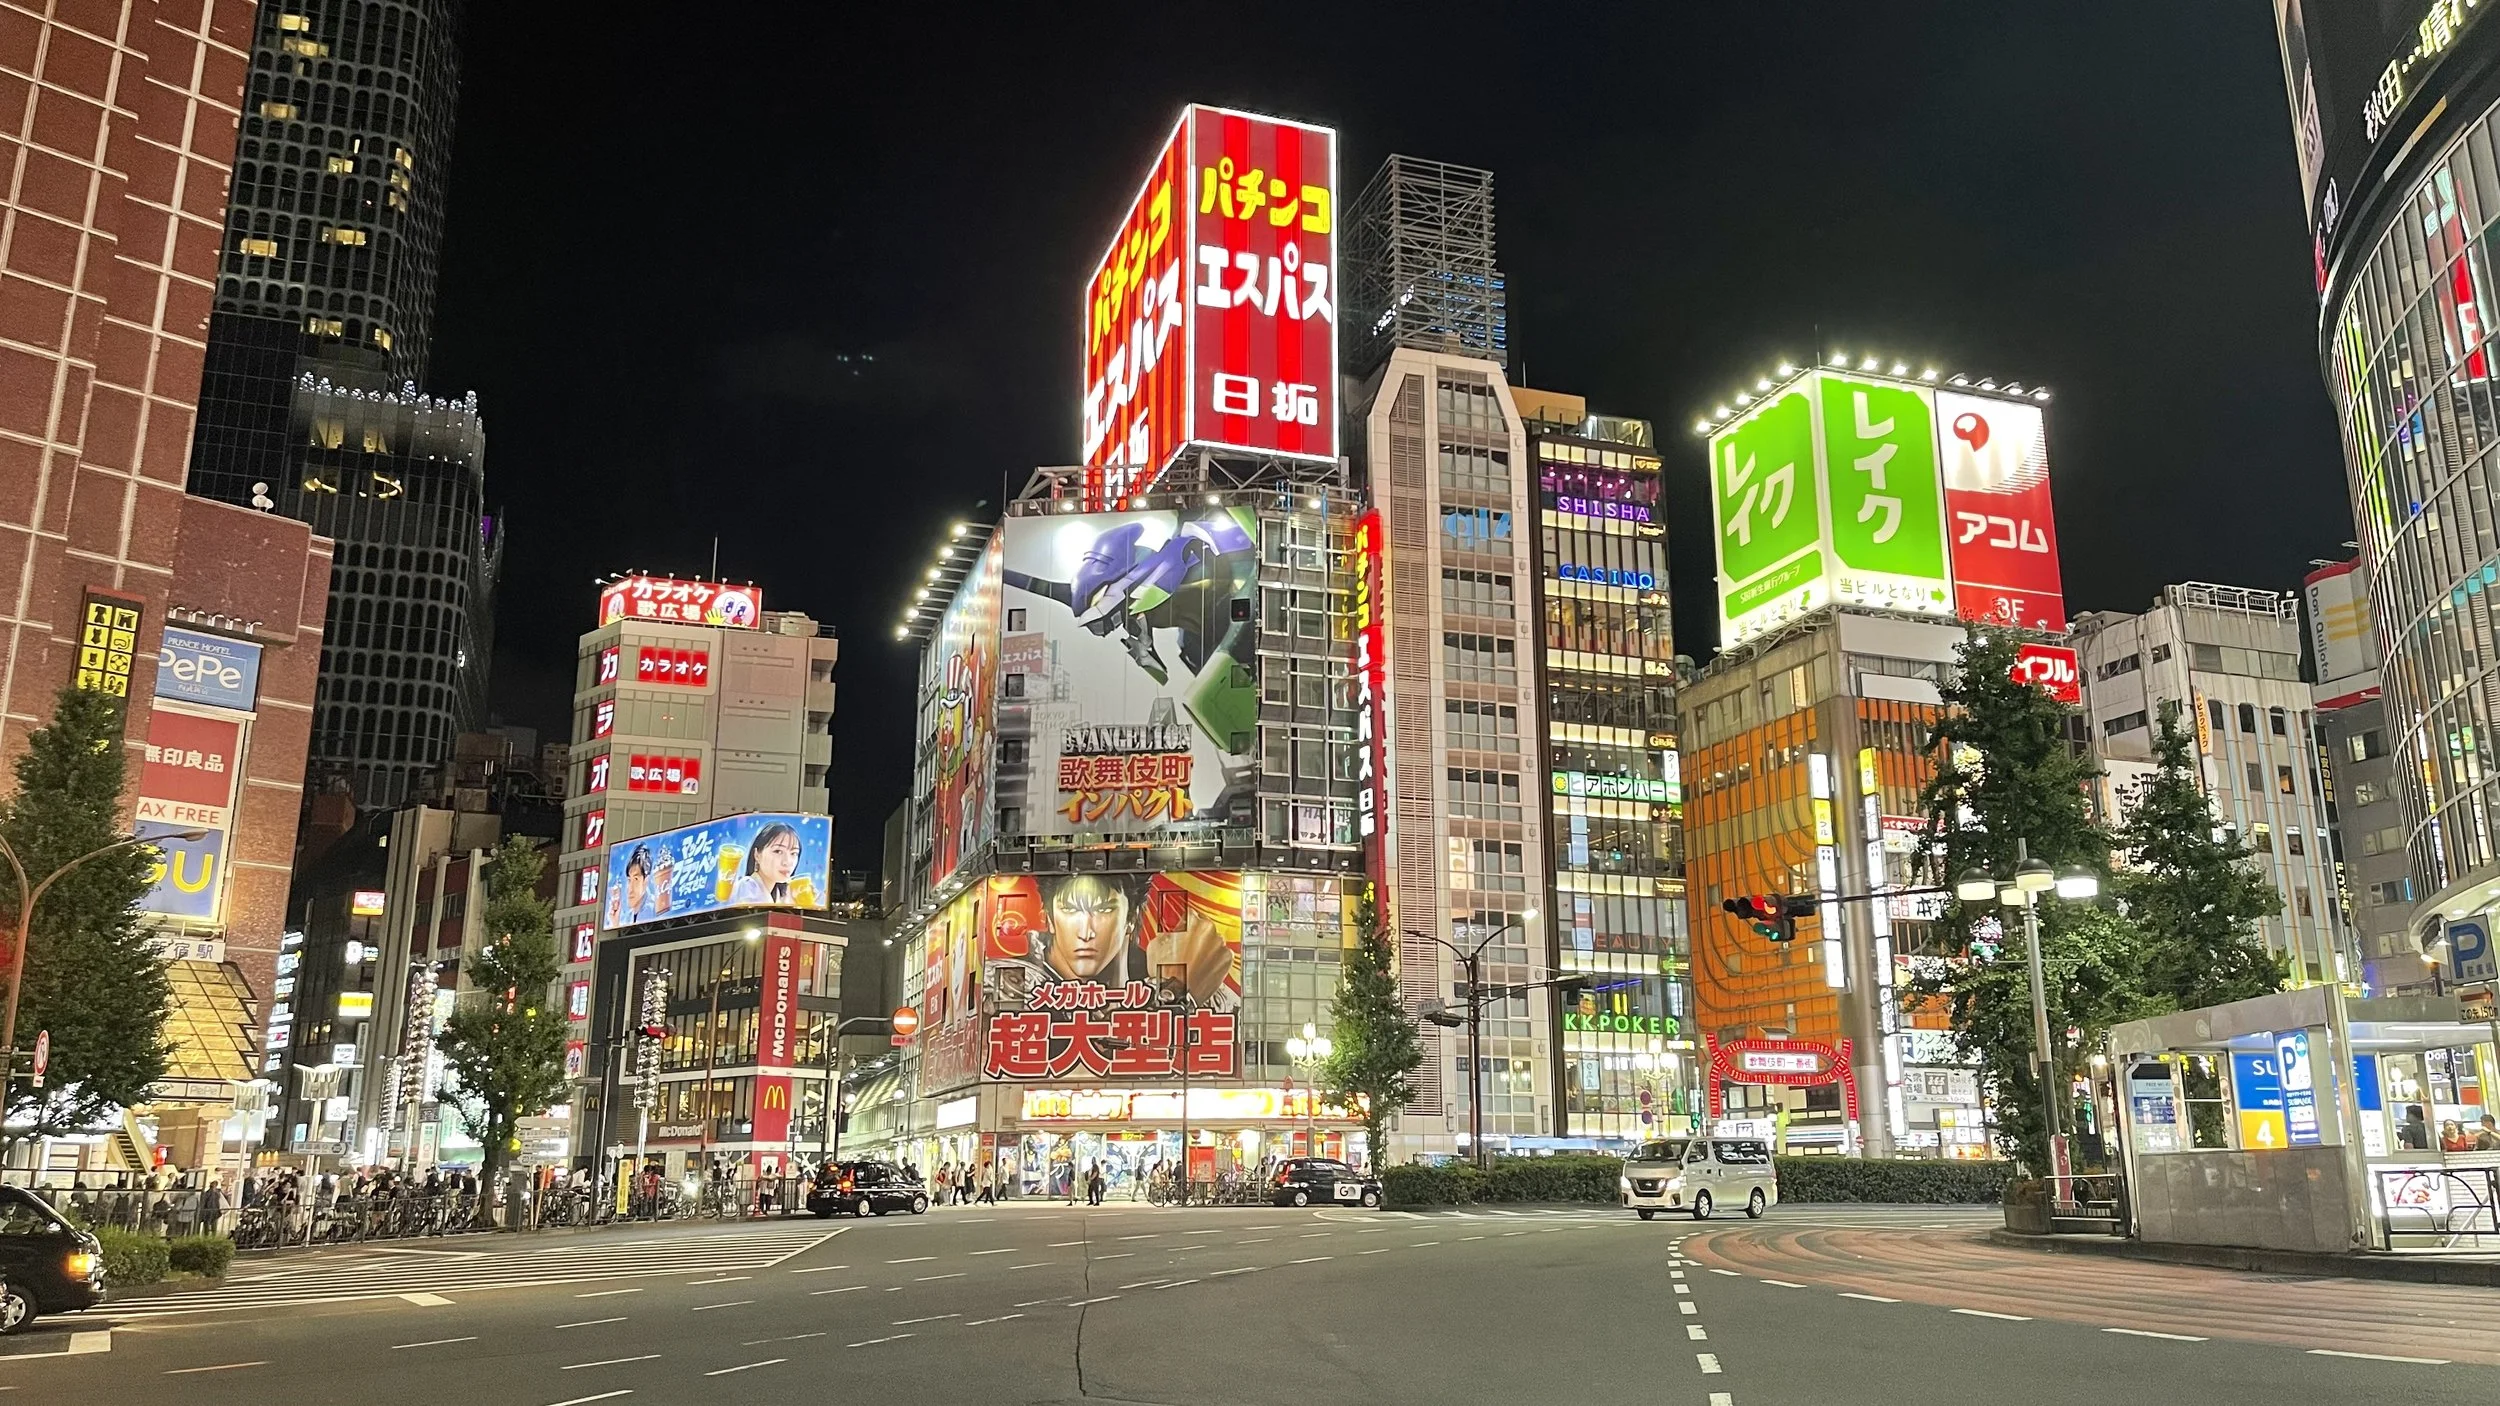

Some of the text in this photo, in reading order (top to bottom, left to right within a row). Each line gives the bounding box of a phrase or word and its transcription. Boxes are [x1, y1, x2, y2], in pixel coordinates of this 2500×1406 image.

[1200, 157, 1331, 234] パチンコ
[1093, 179, 1172, 355] パチンコ
[1197, 242, 1332, 323] エスパス
[1083, 257, 1182, 465] エスパス
[1213, 372, 1319, 426] 日拓
[1853, 391, 1902, 544] レイク
[1559, 496, 1649, 522] SHISHA
[1724, 442, 1795, 547] レイク
[1957, 511, 2049, 554] アコム
[631, 578, 715, 603] カラオケ
[1356, 525, 1370, 629] パチンコ
[1560, 564, 1654, 589] CASINO
[1840, 578, 1926, 602] 当ビルとなり
[636, 600, 701, 621] 歌広場
[1997, 597, 2025, 620] 3F
[201, 642, 232, 656] HOTEL
[2310, 587, 2329, 679] Don Quijote
[640, 657, 708, 676] カラオケ
[1002, 647, 1043, 664] エスパス
[2004, 656, 2075, 683] イフル
[1357, 633, 1373, 782] エスパス
[1061, 724, 1193, 753] EVANGELION
[144, 743, 225, 773] 無印良品
[1060, 755, 1193, 788] 歌舞伎町
[630, 766, 682, 783] 歌広場
[139, 802, 221, 825] AX FREE
[1057, 787, 1194, 823] インパクト
[2449, 923, 2486, 979] P
[772, 946, 792, 1059] McDonald's
[1028, 979, 1152, 1010] メガホール
[984, 1007, 1238, 1078] 超大型店
[1748, 1056, 1815, 1069] 歌舞伎町一番街
[2282, 1046, 2297, 1085] P
[2256, 1119, 2276, 1147] 4
